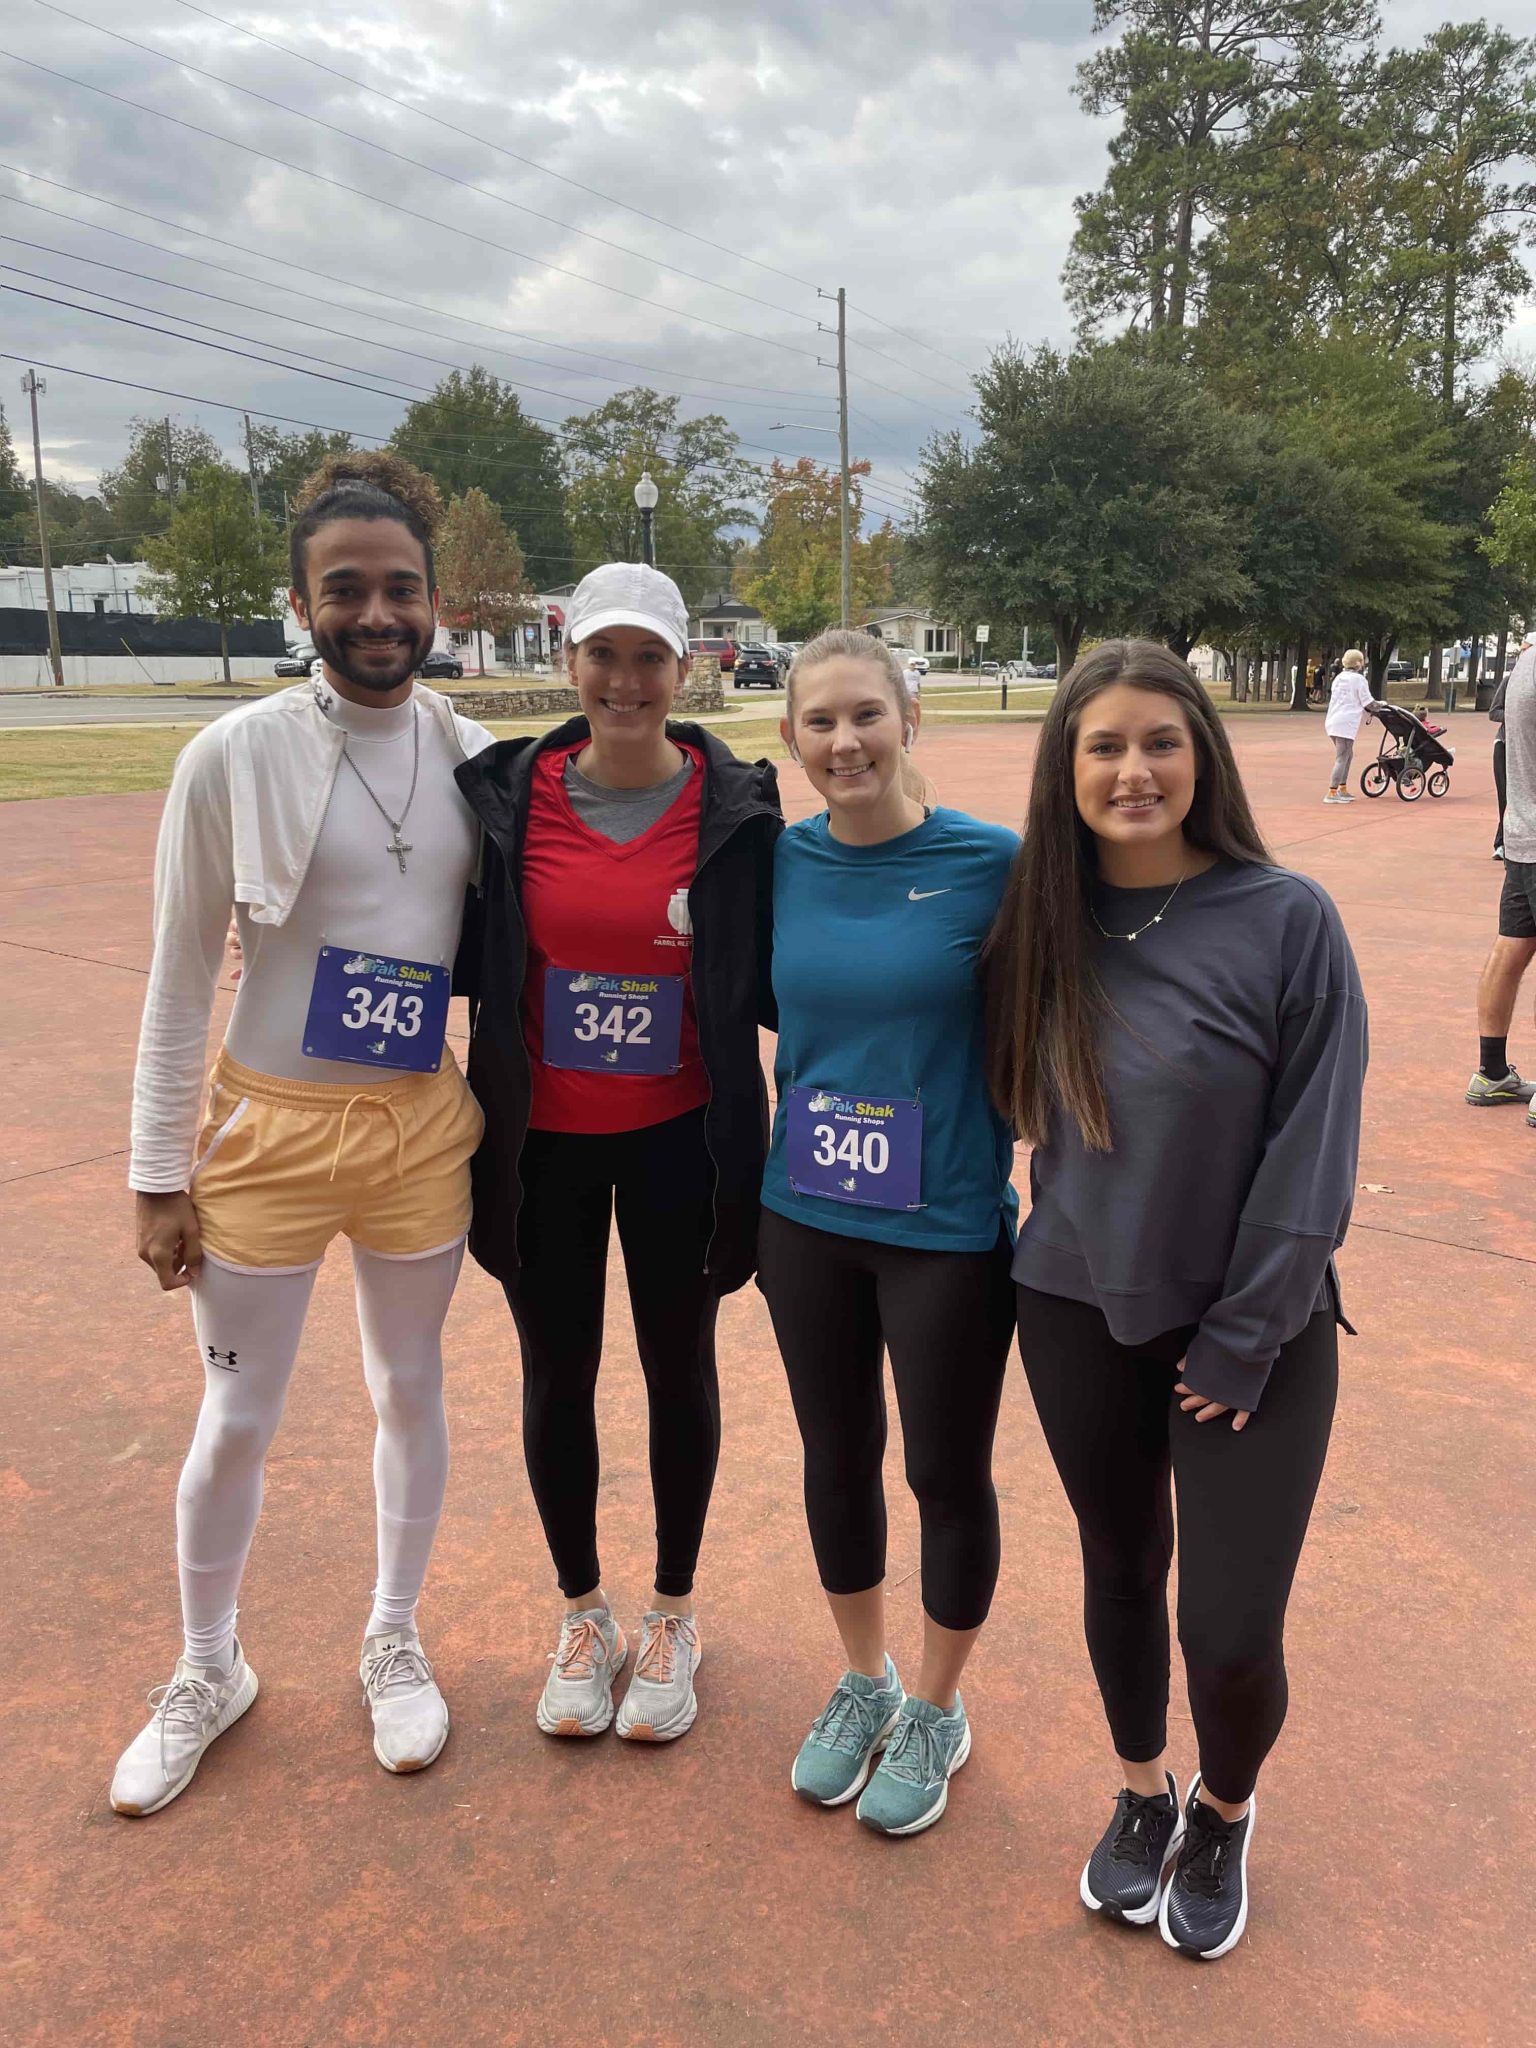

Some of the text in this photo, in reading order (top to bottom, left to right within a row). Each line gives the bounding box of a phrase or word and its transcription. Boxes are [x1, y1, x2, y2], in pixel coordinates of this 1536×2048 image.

[374, 975, 423, 989] Running Shops
[398, 966, 432, 982] Shak
[621, 980, 658, 992] Shak
[598, 991, 627, 1000] Running
[342, 986, 424, 1037] 343
[574, 1003, 653, 1044] 342
[855, 1102, 895, 1118] Shak
[834, 1113, 885, 1126] Running Shops
[813, 1124, 890, 1174] 340
